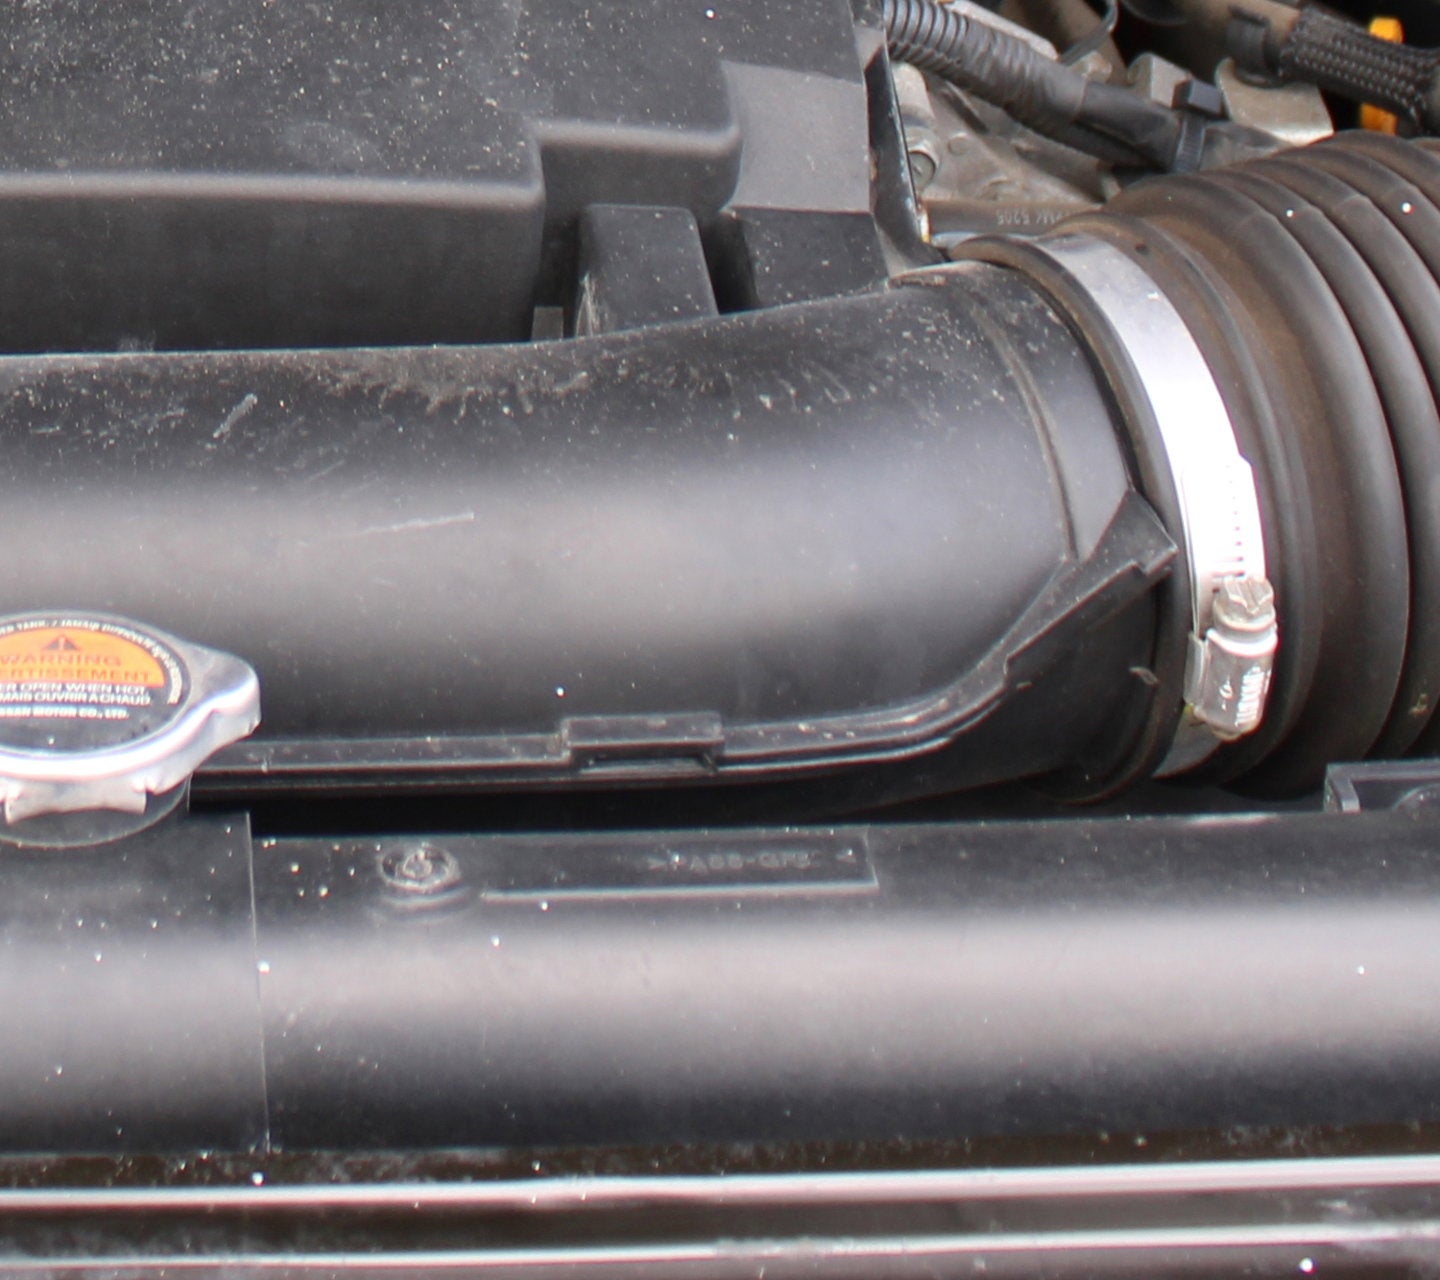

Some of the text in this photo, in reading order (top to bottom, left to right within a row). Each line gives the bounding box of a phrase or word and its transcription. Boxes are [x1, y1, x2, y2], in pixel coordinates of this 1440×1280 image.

[19, 682, 62, 693] OPEN
[65, 682, 113, 693] WHEN
[34, 692, 88, 704] OUVRIR
[33, 706, 78, 719] MOTOR
